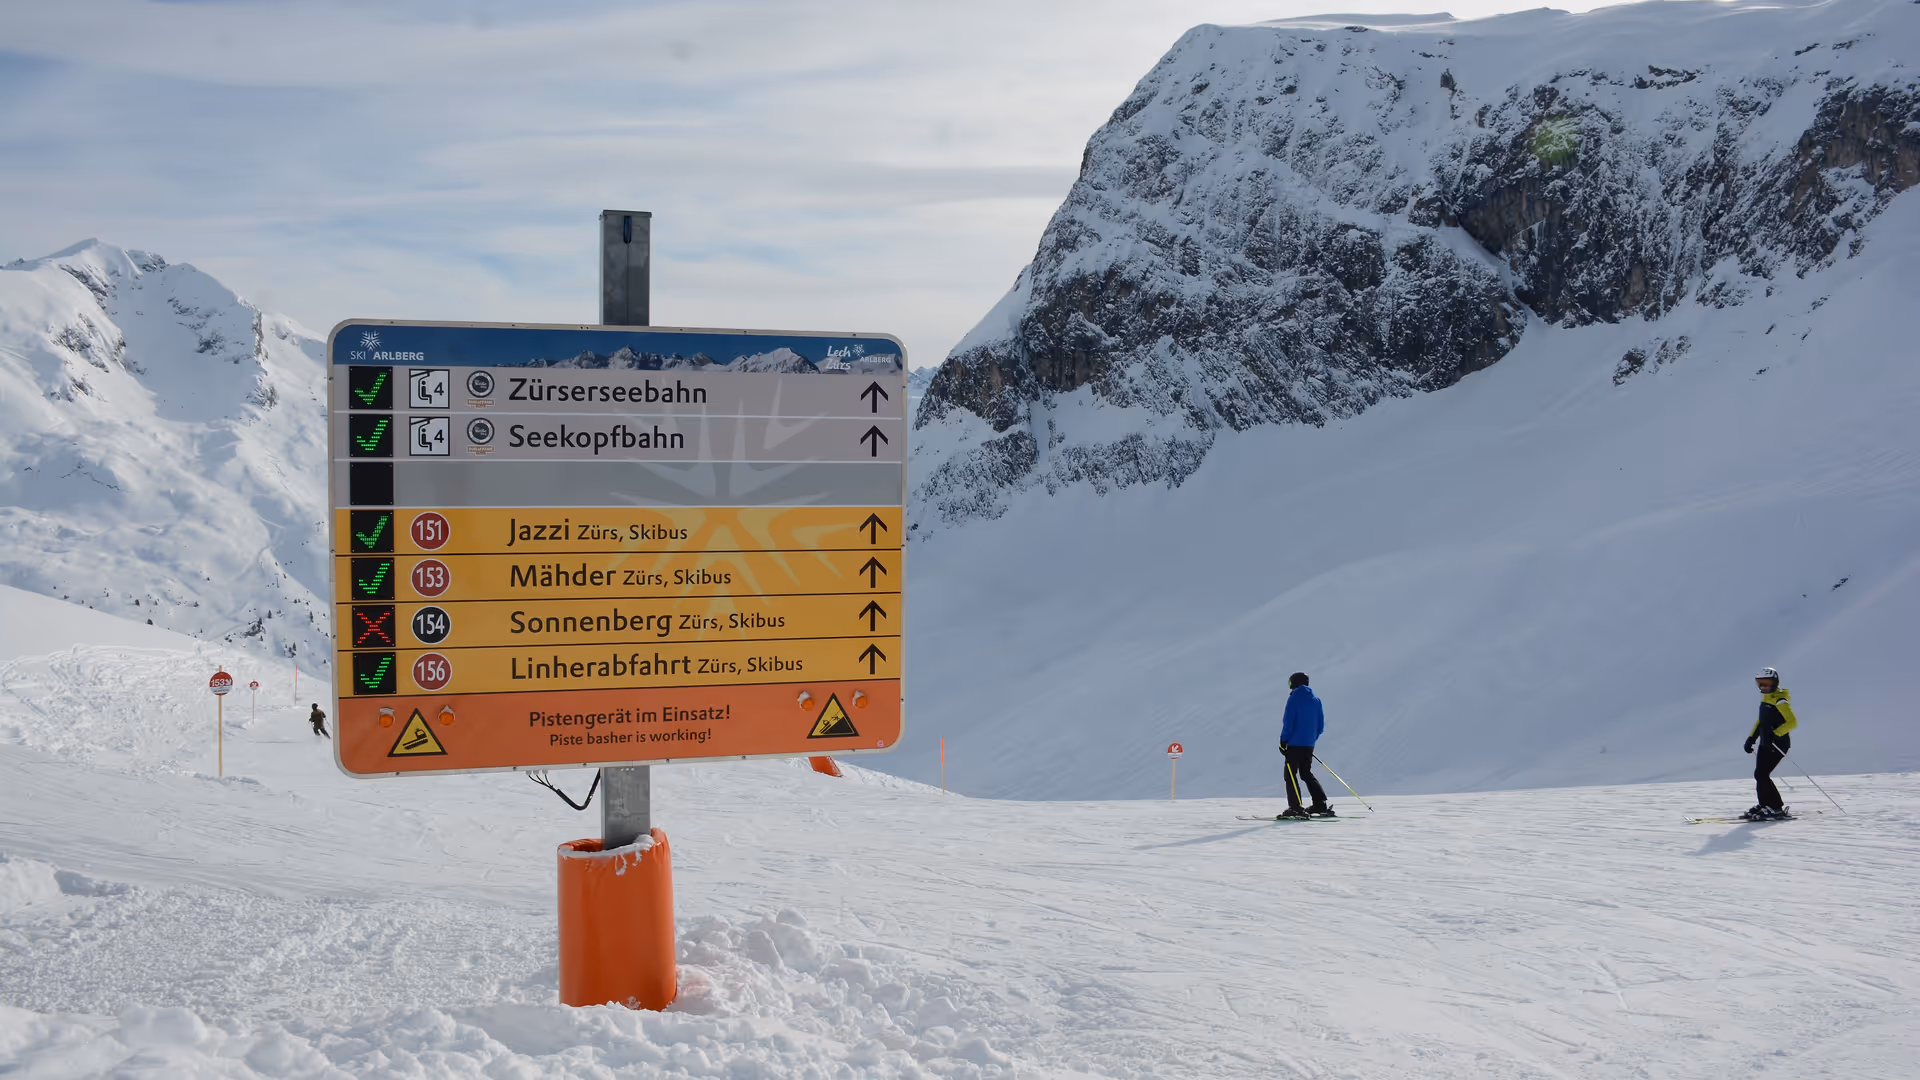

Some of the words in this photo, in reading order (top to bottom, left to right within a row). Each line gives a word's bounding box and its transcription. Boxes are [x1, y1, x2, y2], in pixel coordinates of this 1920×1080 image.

[350, 351, 366, 360] SKI
[373, 351, 424, 361] ARLBERG
[827, 345, 851, 357] Lech
[826, 358, 851, 370] Zürs
[434, 382, 444, 396] 4
[508, 377, 707, 404] Zürserseebahn
[434, 429, 444, 443] 4
[509, 424, 684, 456] Seekopfbahn
[416, 519, 443, 541] 151
[507, 518, 569, 546] Jazzi
[577, 523, 623, 543] Zürs,
[629, 523, 688, 541] Skibus
[416, 566, 444, 588] 153
[510, 563, 617, 587] Mähder
[622, 568, 668, 588] Zürs,
[673, 568, 731, 586] Skibus
[416, 614, 445, 635] 154
[510, 607, 673, 637] Sonnenberg
[678, 612, 723, 632] Zürs,
[728, 612, 785, 630] Skibus
[417, 660, 446, 682] 156
[511, 653, 692, 680] Linherabfahrt
[697, 656, 742, 676] Zürs,
[747, 656, 803, 673] Skibus
[211, 679, 224, 687] 153
[529, 708, 631, 729] Pistengerät
[636, 707, 657, 722] im
[662, 704, 730, 723] Einsatz!
[550, 732, 583, 746] Piste
[586, 729, 633, 745] basher
[636, 730, 647, 743] is
[649, 727, 712, 746] working!
